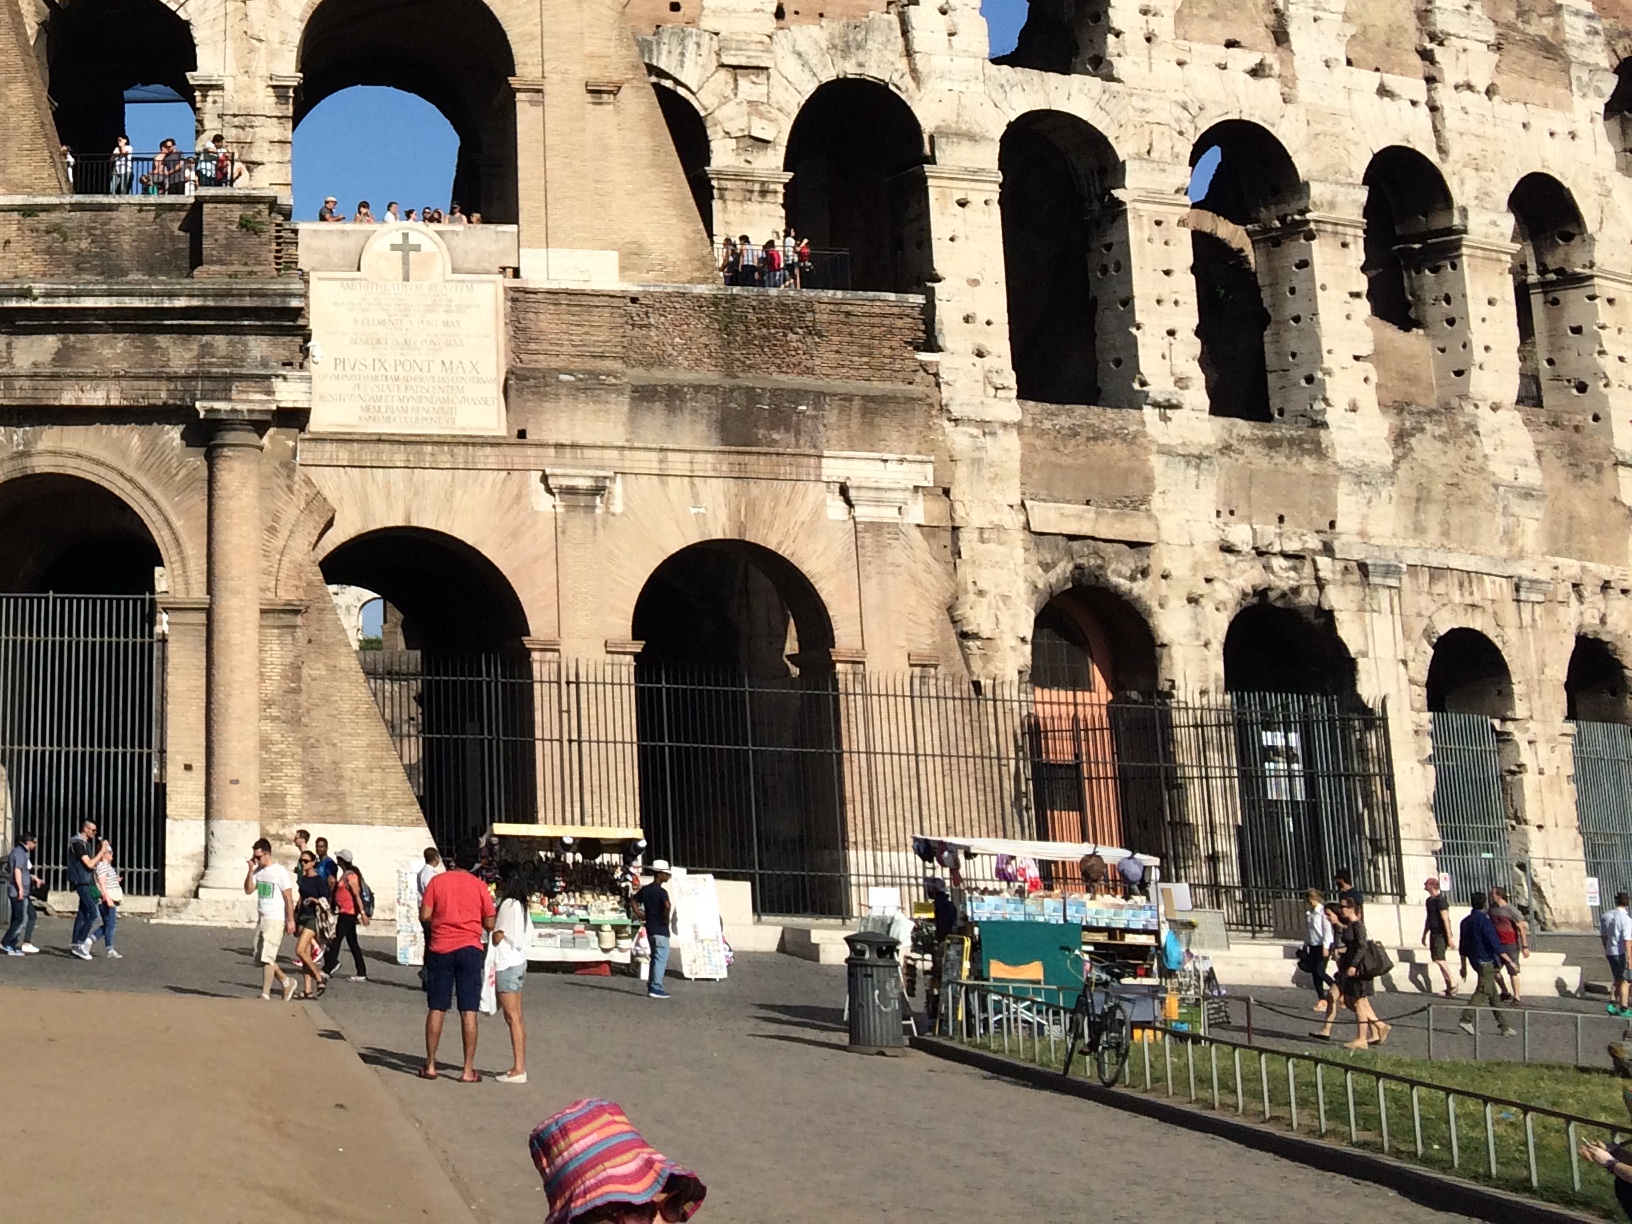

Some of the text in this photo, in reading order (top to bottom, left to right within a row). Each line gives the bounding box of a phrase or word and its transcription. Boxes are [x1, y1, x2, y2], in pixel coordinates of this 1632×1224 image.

[333, 357, 480, 375] PIVS IX PONT MAX
